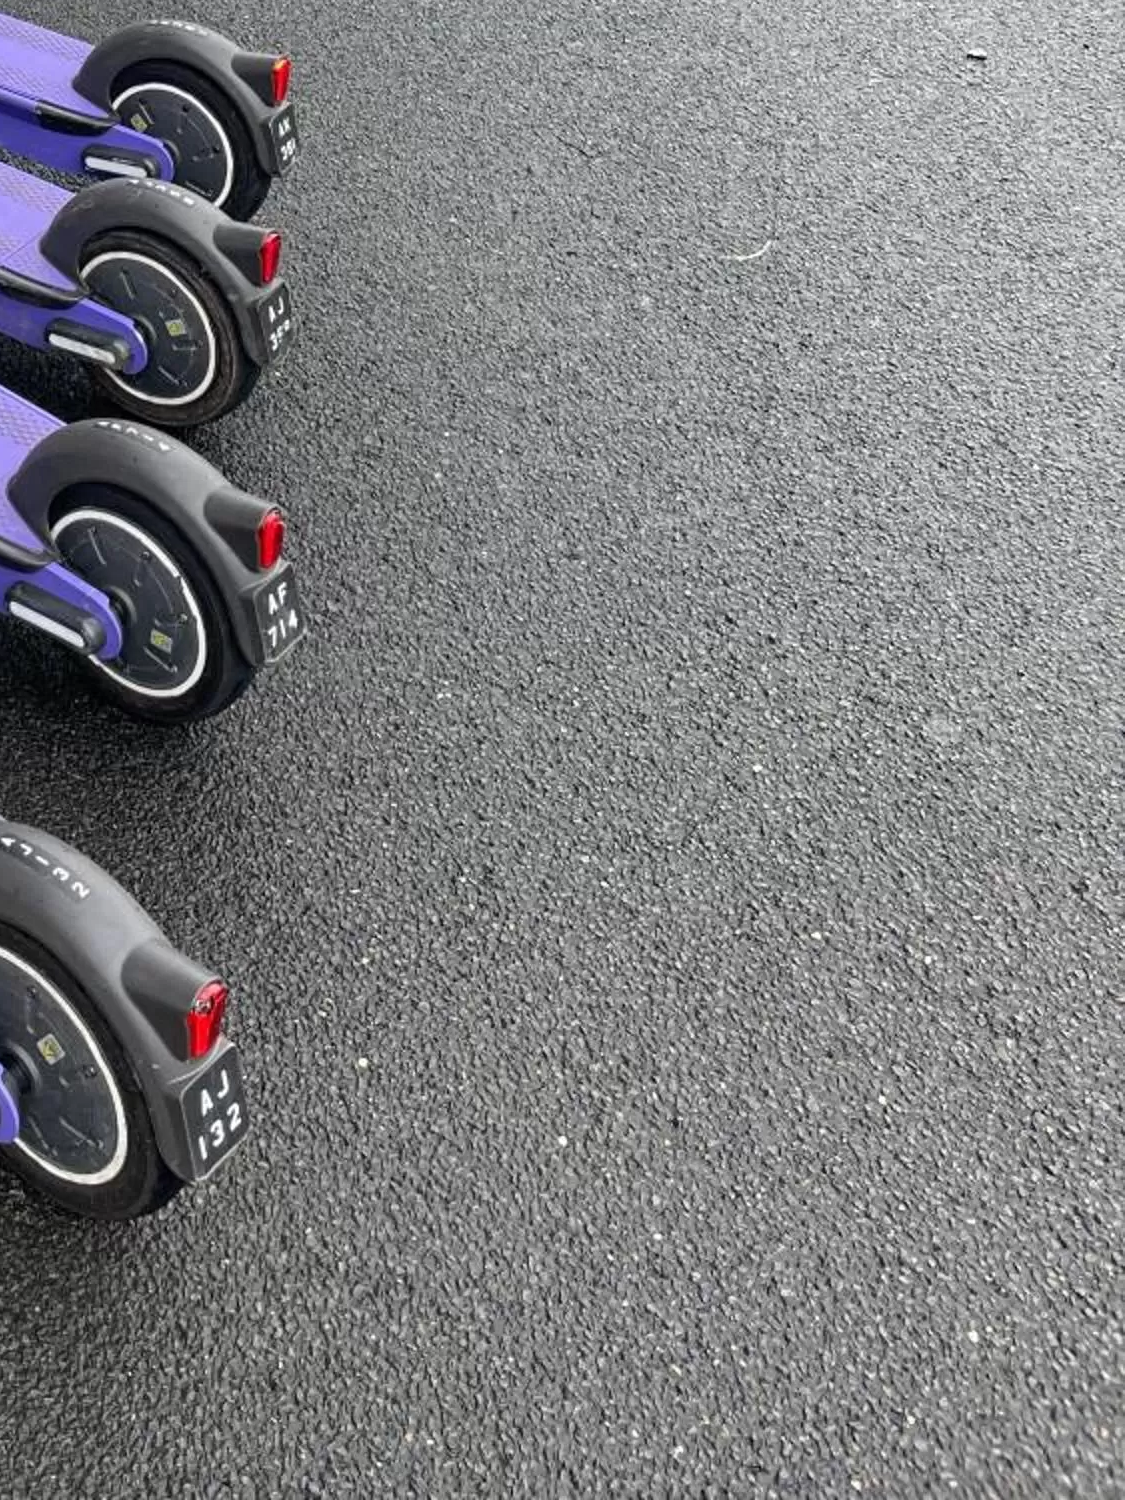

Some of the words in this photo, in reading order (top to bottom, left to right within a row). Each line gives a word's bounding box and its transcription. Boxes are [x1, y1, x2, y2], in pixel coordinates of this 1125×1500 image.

[268, 581, 288, 615] AF
[267, 608, 298, 649] 714
[0, 837, 91, 898] AJ132
[200, 1068, 230, 1117] AJ
[198, 1102, 242, 1161] 132
